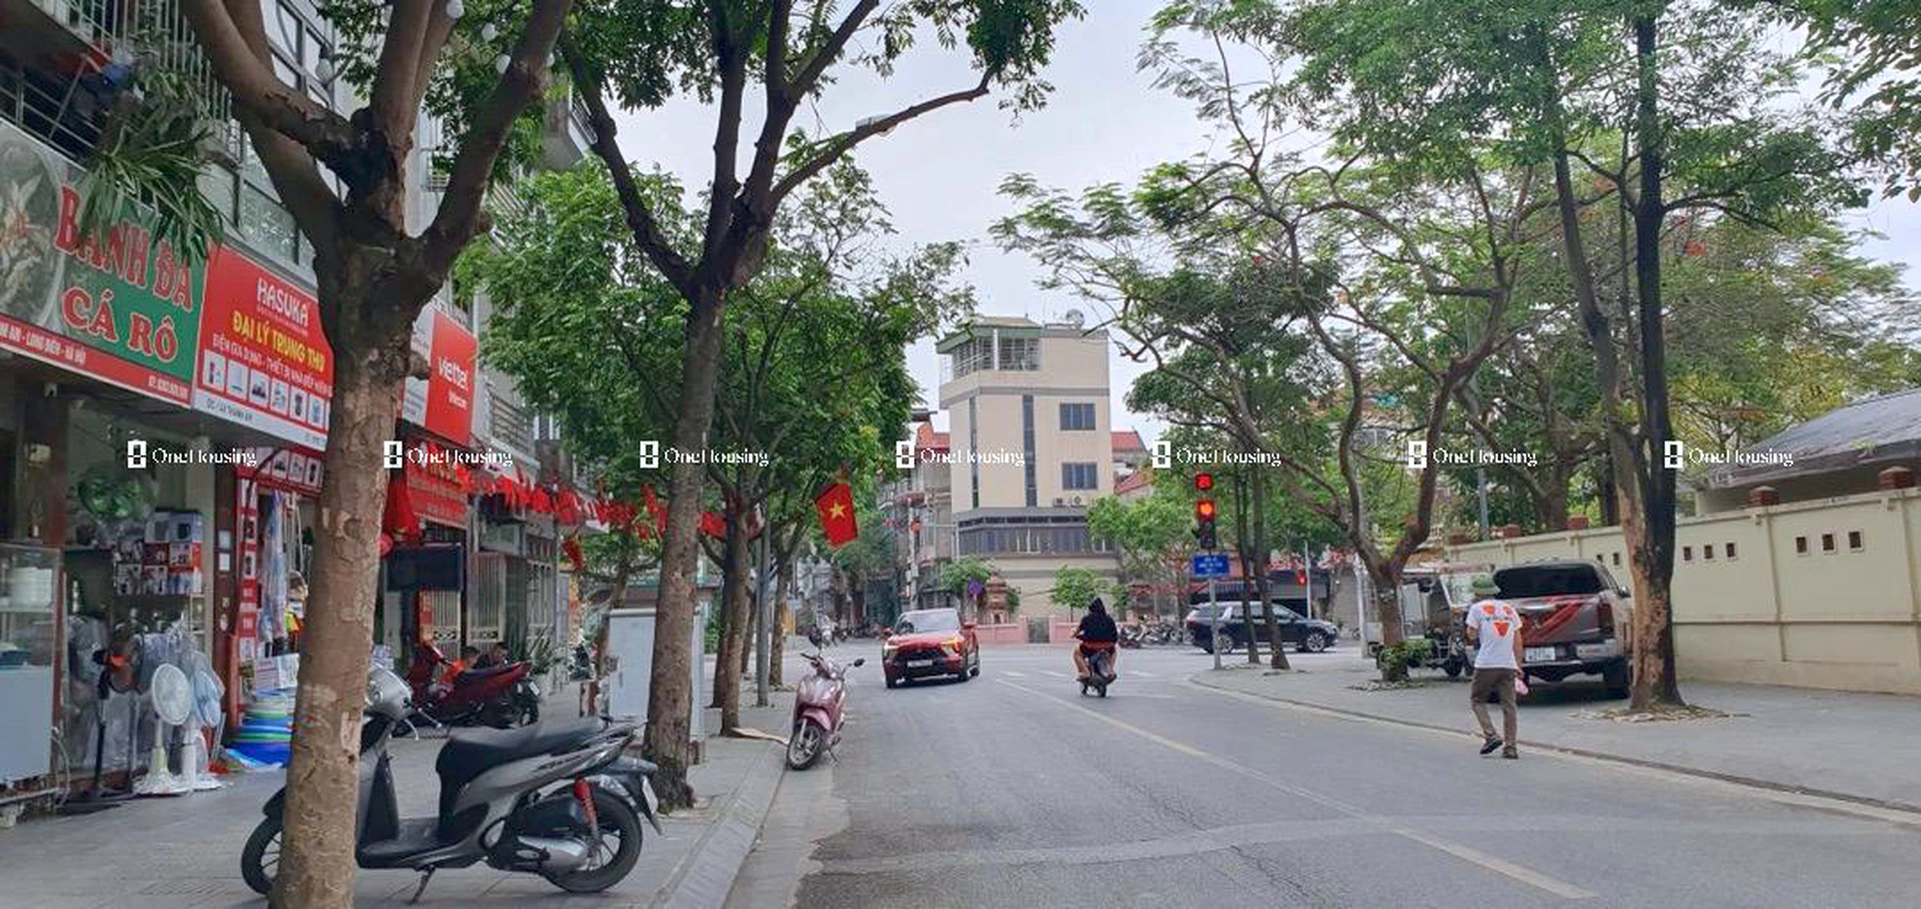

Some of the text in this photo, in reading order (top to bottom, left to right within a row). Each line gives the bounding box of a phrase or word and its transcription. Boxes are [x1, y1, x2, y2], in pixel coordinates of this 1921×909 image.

[61, 286, 178, 363] CÁ RÔ
[257, 277, 309, 328] HASUKA
[232, 310, 255, 342] ĐẠI
[256, 320, 270, 345] LÝ
[272, 329, 305, 363] TRUNG
